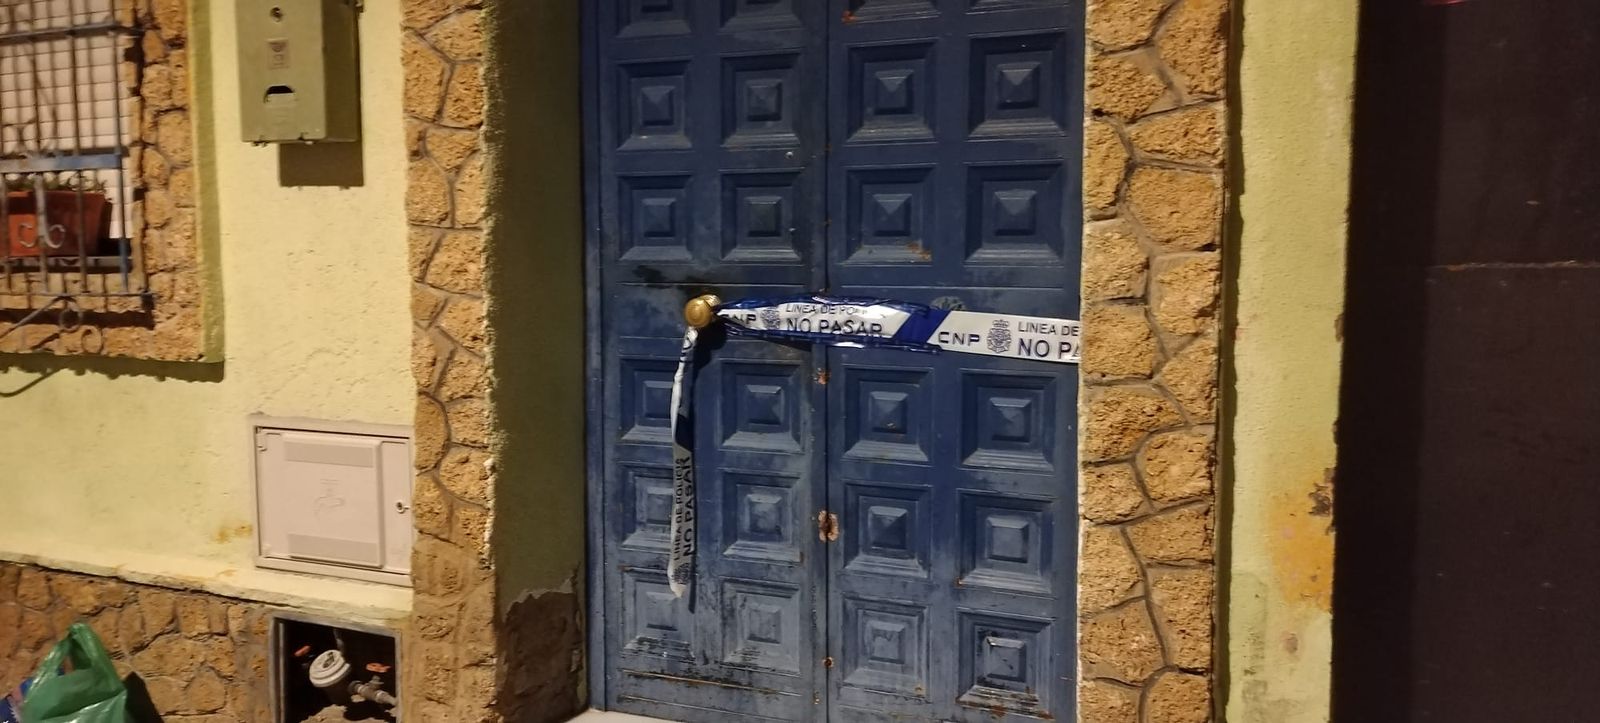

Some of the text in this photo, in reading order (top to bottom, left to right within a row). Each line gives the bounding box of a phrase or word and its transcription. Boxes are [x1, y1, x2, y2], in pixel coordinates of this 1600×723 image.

[786, 304, 817, 314] LINEA
[821, 305, 836, 315] DE
[787, 318, 811, 333] NO
[1018, 321, 1079, 337] LINEA DE
[938, 331, 980, 346] CNP
[1018, 337, 1050, 358] NO
[675, 508, 682, 523] DE
